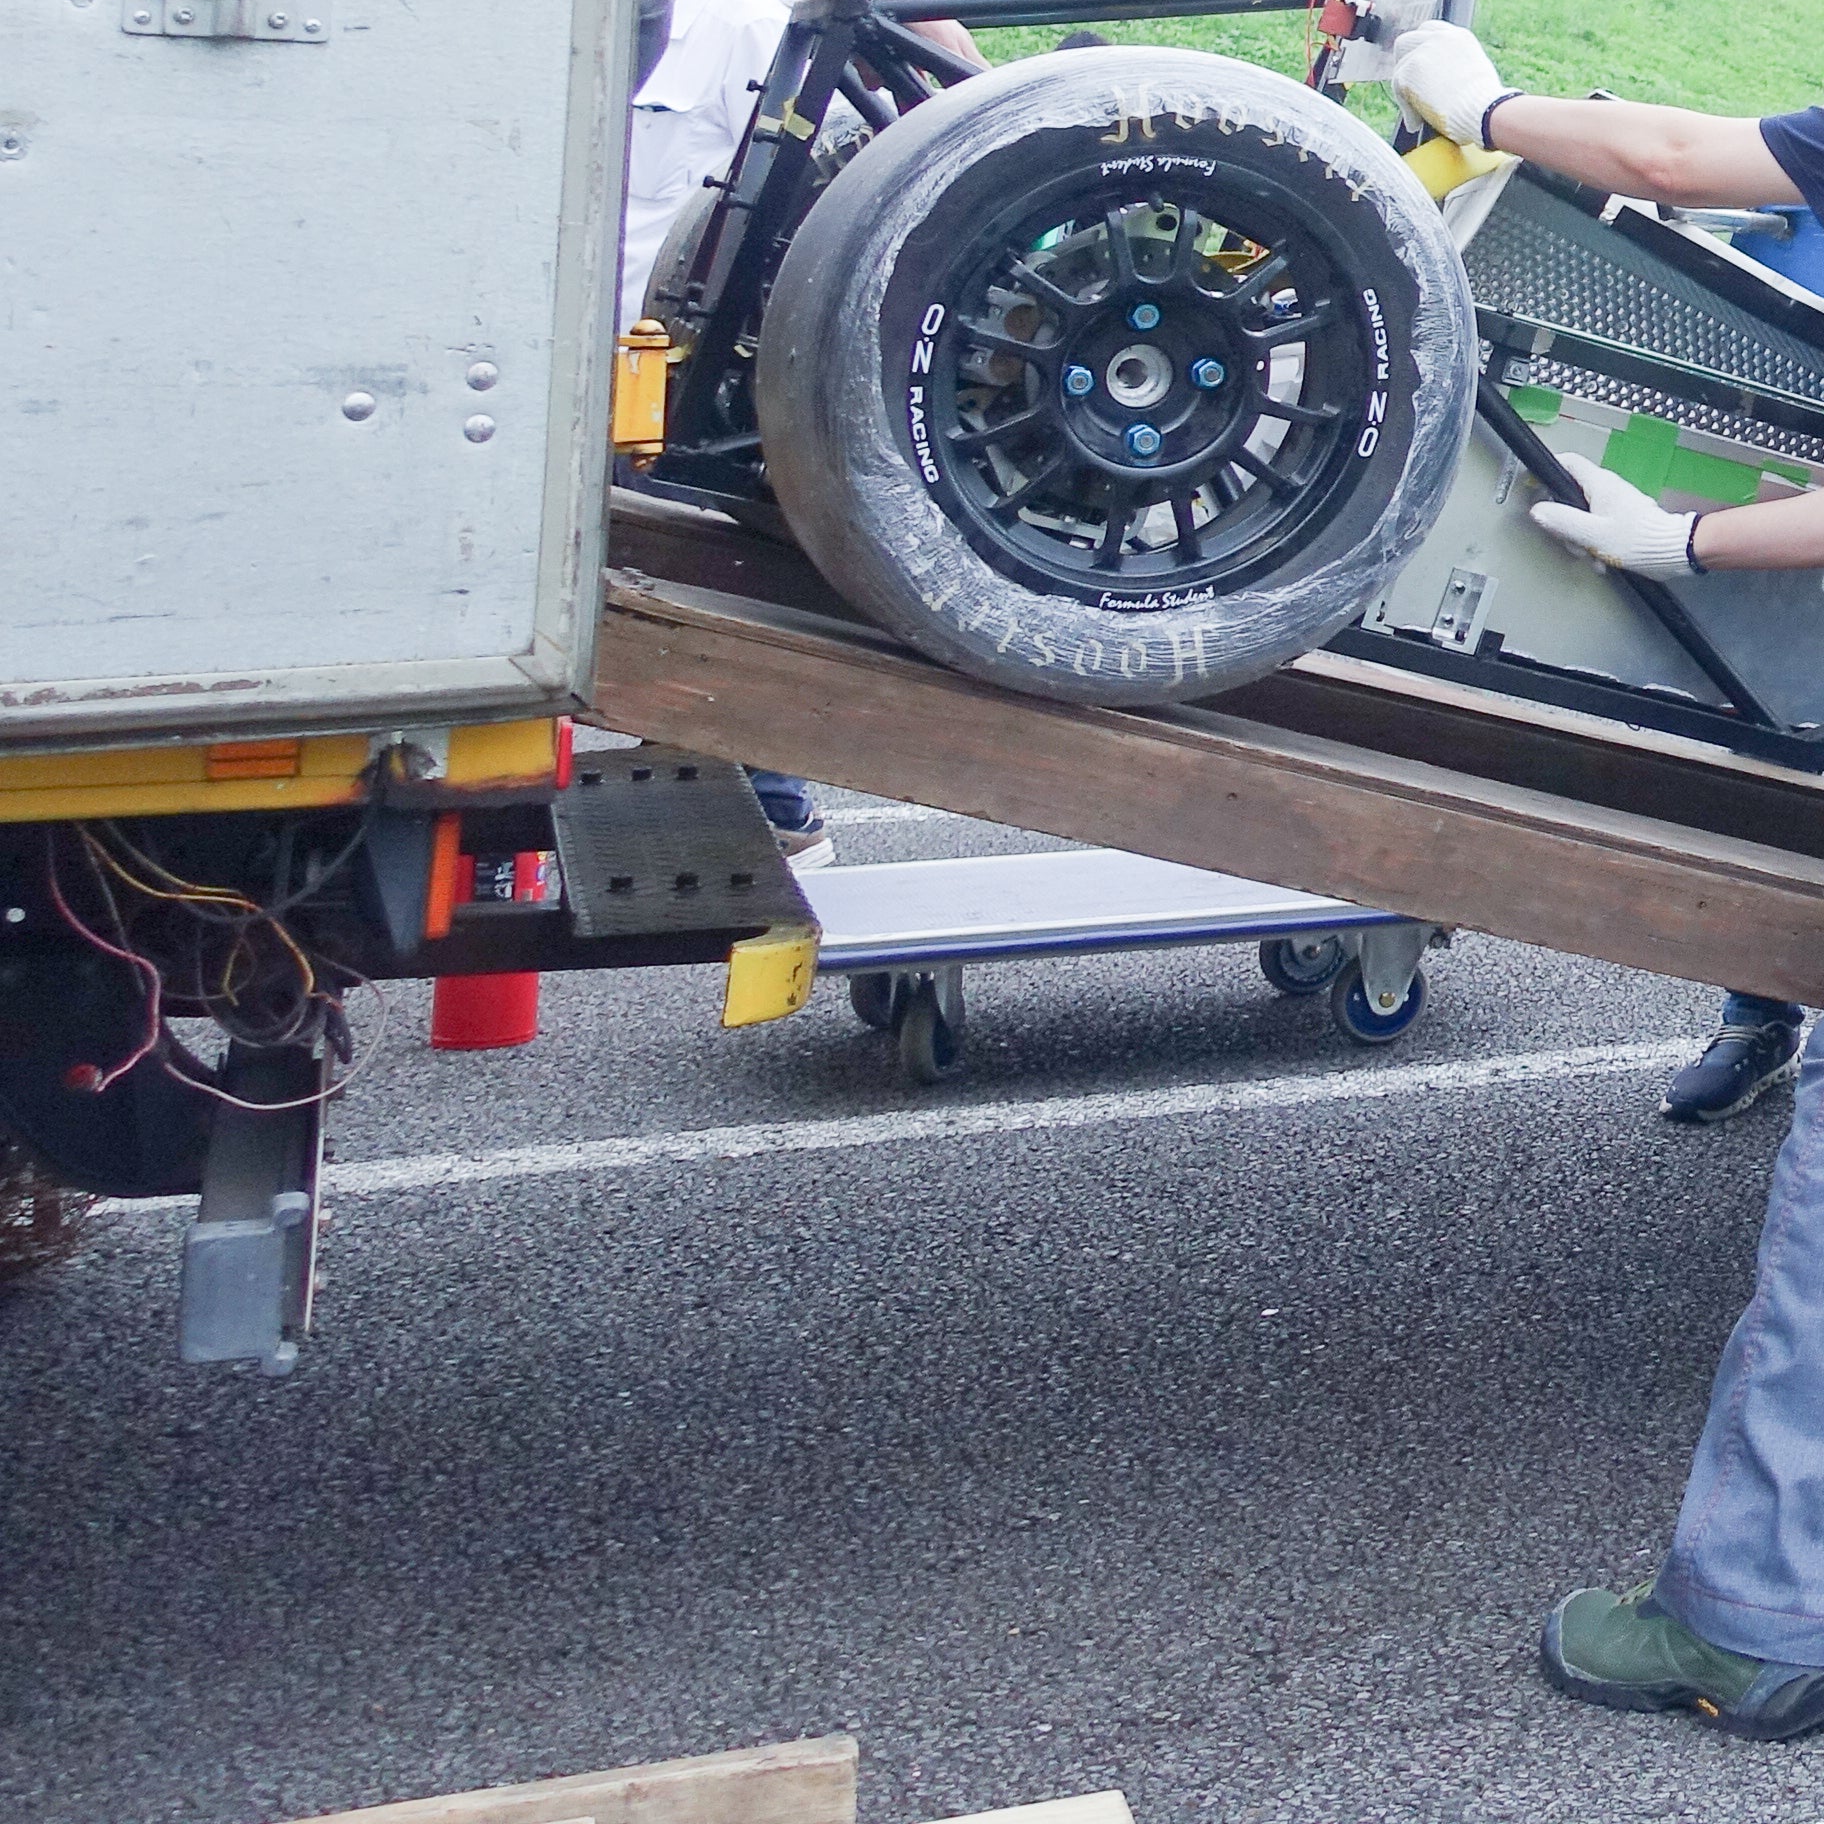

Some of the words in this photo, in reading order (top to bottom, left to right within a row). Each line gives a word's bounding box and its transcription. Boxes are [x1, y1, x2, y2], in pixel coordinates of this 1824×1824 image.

[1154, 155, 1218, 177] Formula
[1362, 288, 1389, 380] RACING
[910, 386, 940, 485] RACING
[1099, 592, 1160, 612] Formula
[1160, 585, 1216, 610] Student
